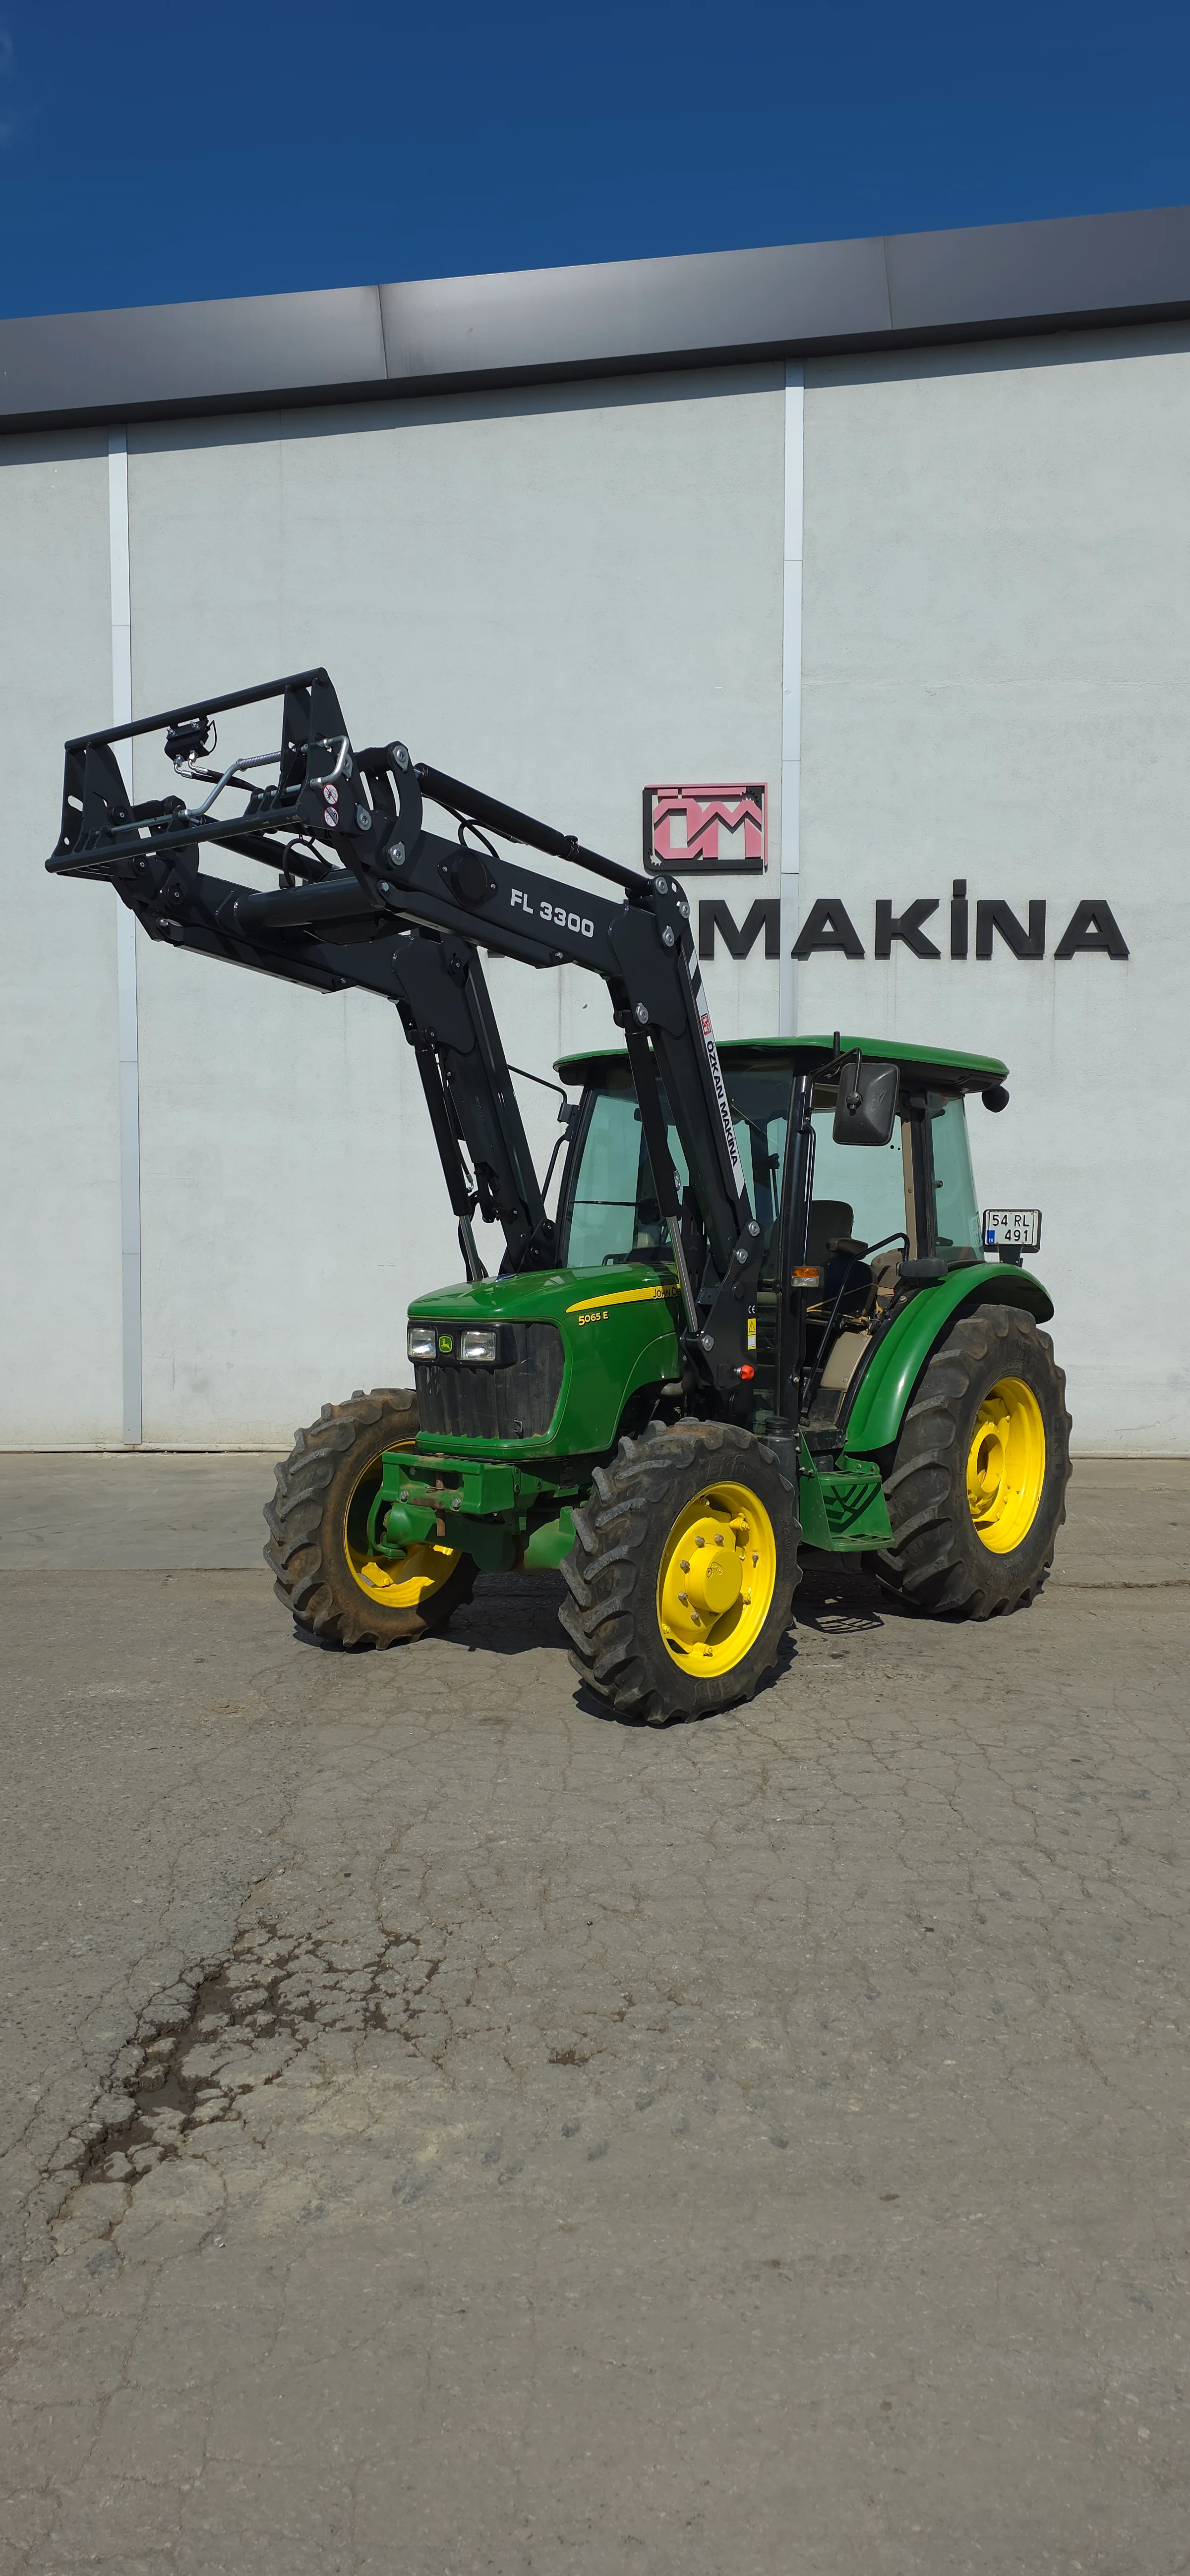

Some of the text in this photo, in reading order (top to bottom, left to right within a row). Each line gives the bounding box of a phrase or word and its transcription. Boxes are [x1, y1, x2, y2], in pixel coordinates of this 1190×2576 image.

[510, 888, 595, 938] FL 3300
[699, 879, 1130, 960] MAKİNA
[706, 1040, 738, 1168] ÖZKAN MAKİNA
[992, 1214, 1030, 1227] 54 RL
[1004, 1229, 1028, 1242] 491
[653, 1289, 671, 1298] JOHN
[748, 1305, 756, 1314] CE
[578, 1311, 609, 1326] 5065 E
